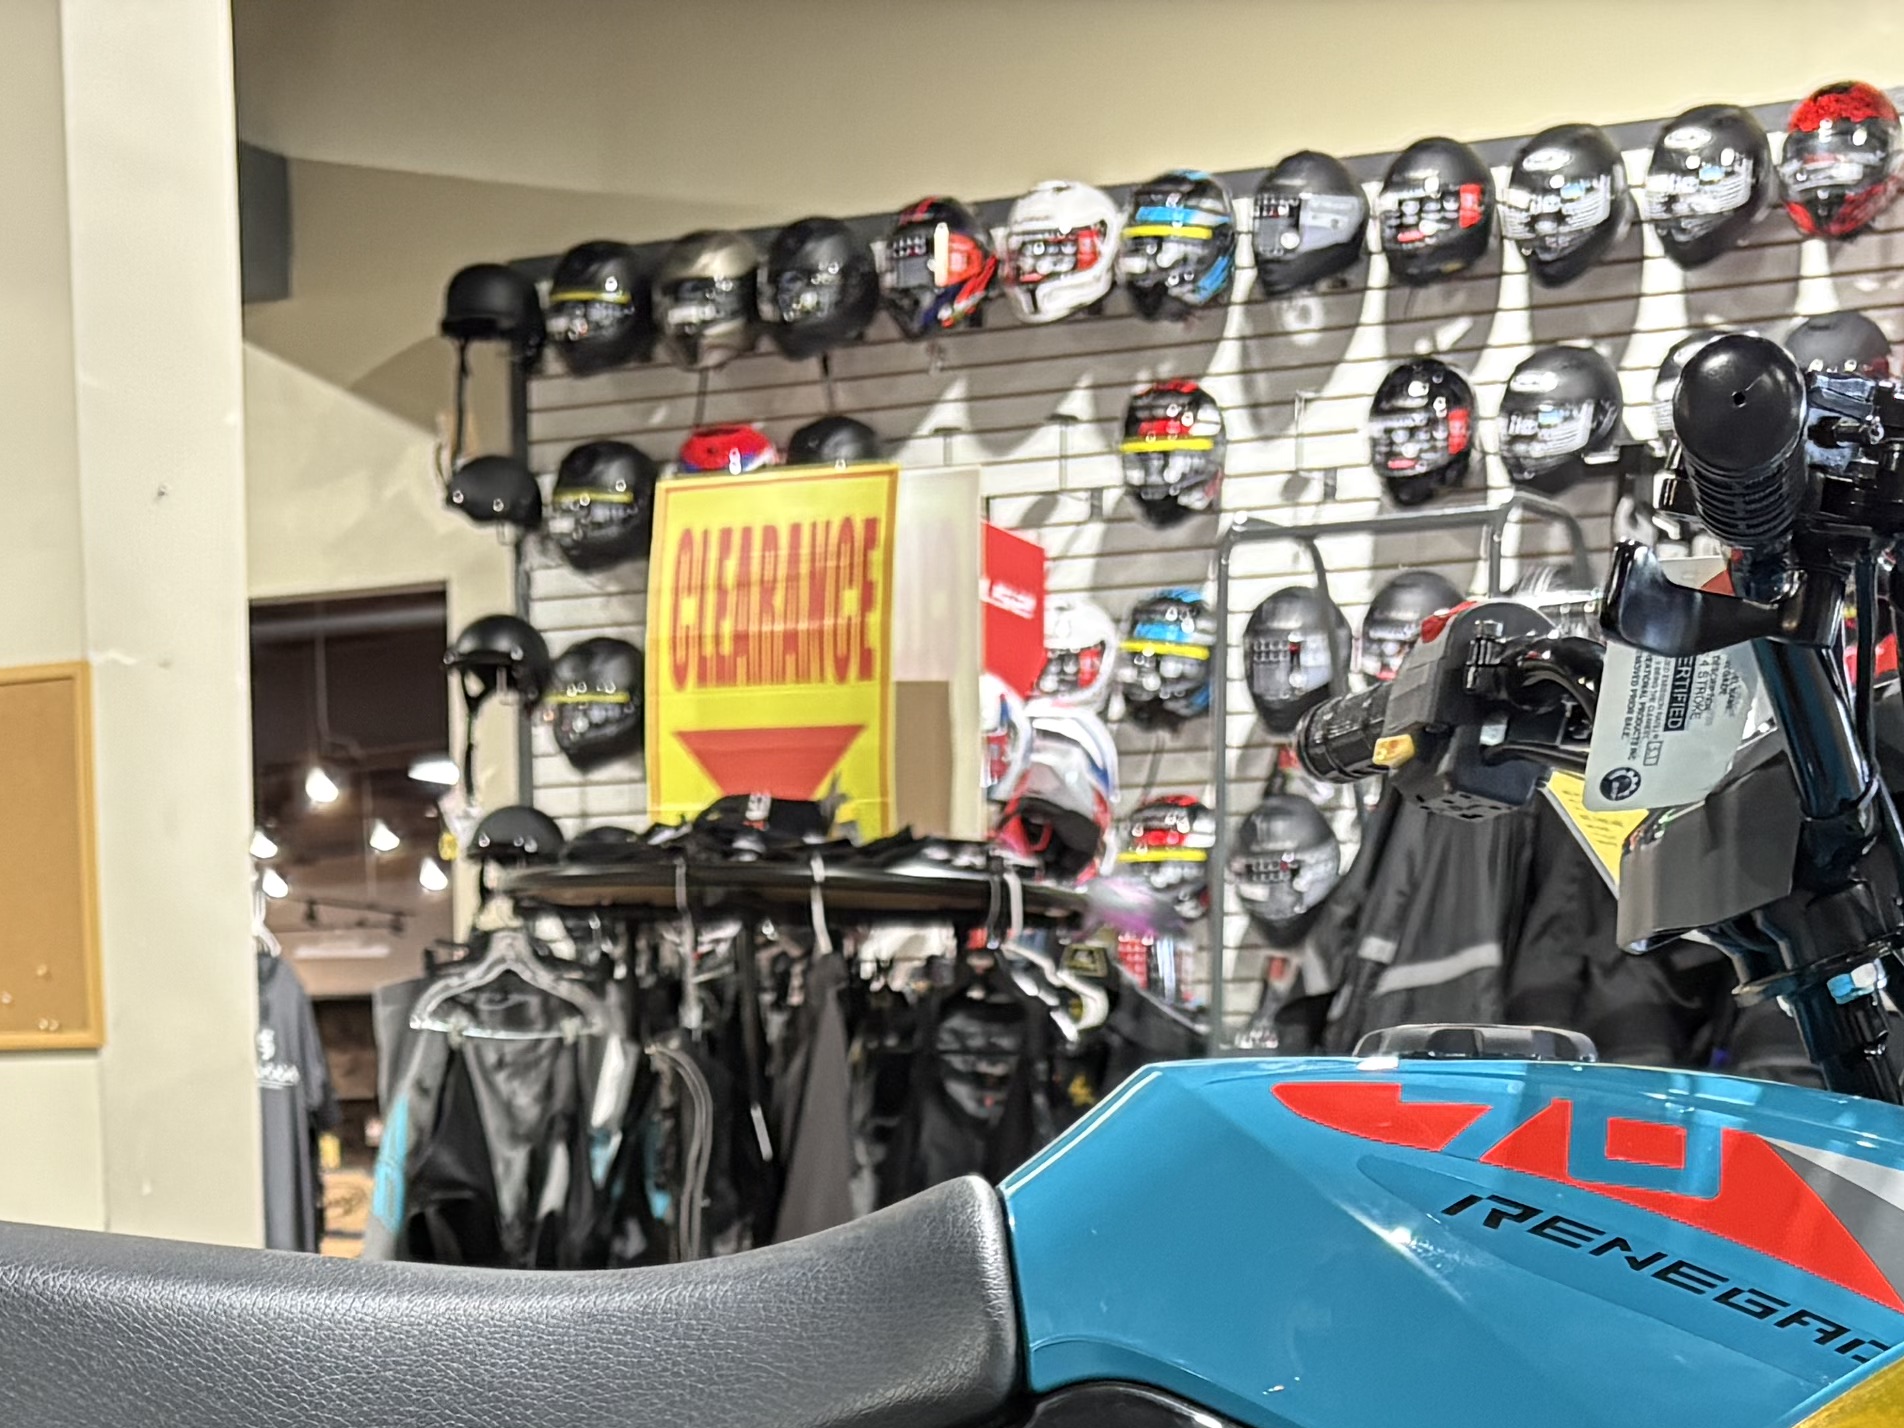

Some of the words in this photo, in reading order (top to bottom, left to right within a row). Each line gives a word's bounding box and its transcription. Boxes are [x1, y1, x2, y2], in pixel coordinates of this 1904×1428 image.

[671, 515, 881, 691] CLEARANCE
[1667, 655, 1693, 730] ERTIFIED
[1689, 670, 1709, 722] STROKE
